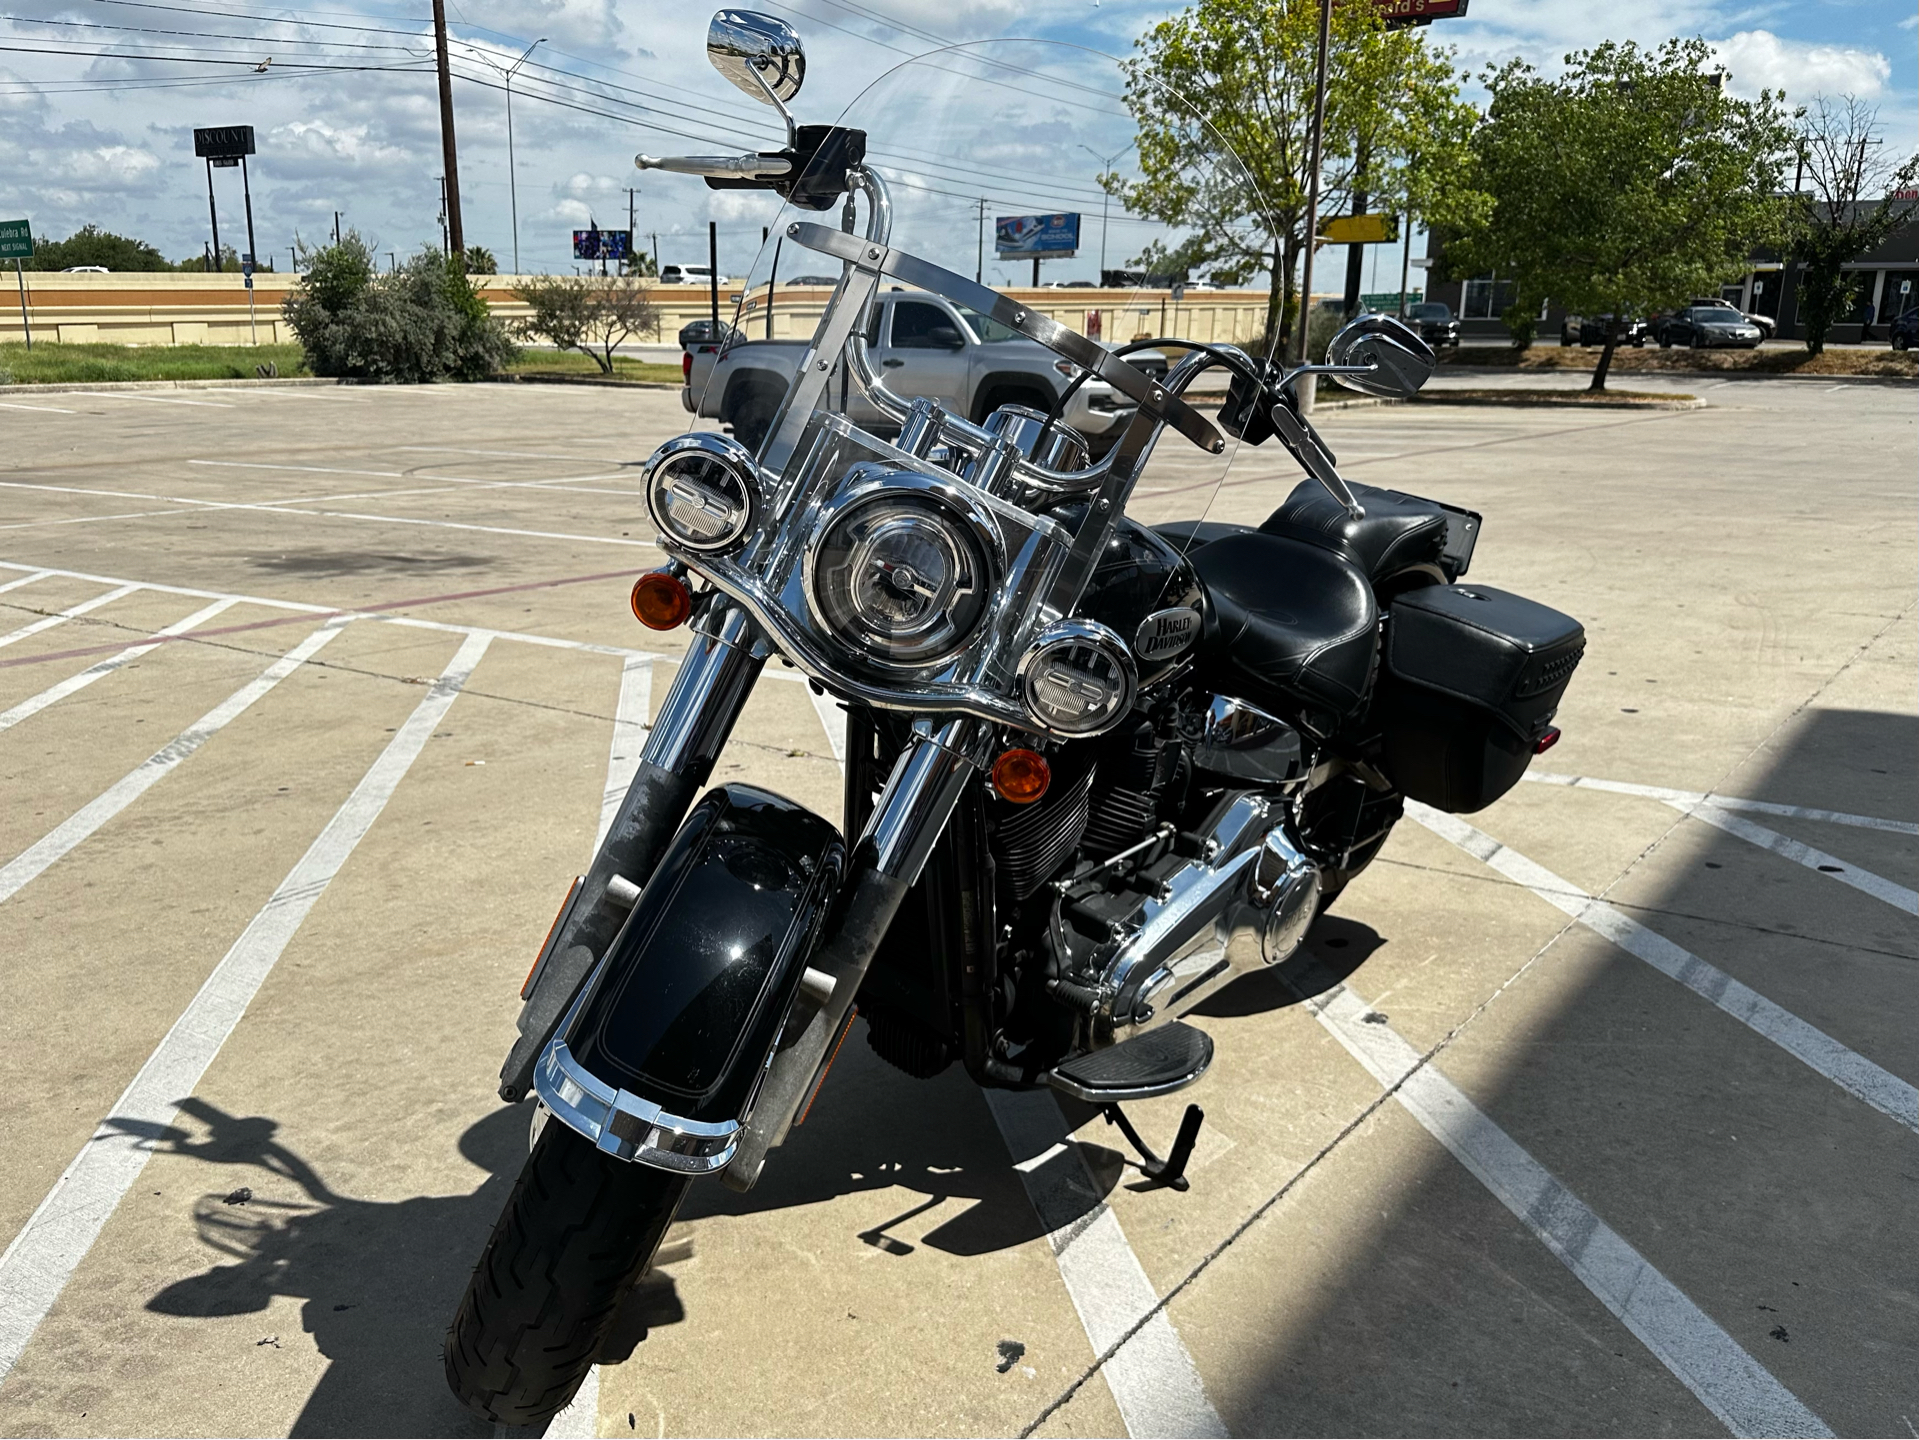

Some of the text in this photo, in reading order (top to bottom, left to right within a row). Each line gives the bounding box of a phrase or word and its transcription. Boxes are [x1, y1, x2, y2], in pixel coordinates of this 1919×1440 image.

[194, 127, 246, 145] DISCOUNT
[20, 226, 29, 237] Rd
[12, 242, 28, 251] SIGNAL
[1155, 617, 1193, 637] HARLEY
[1144, 630, 1193, 654] DAVIDSON
